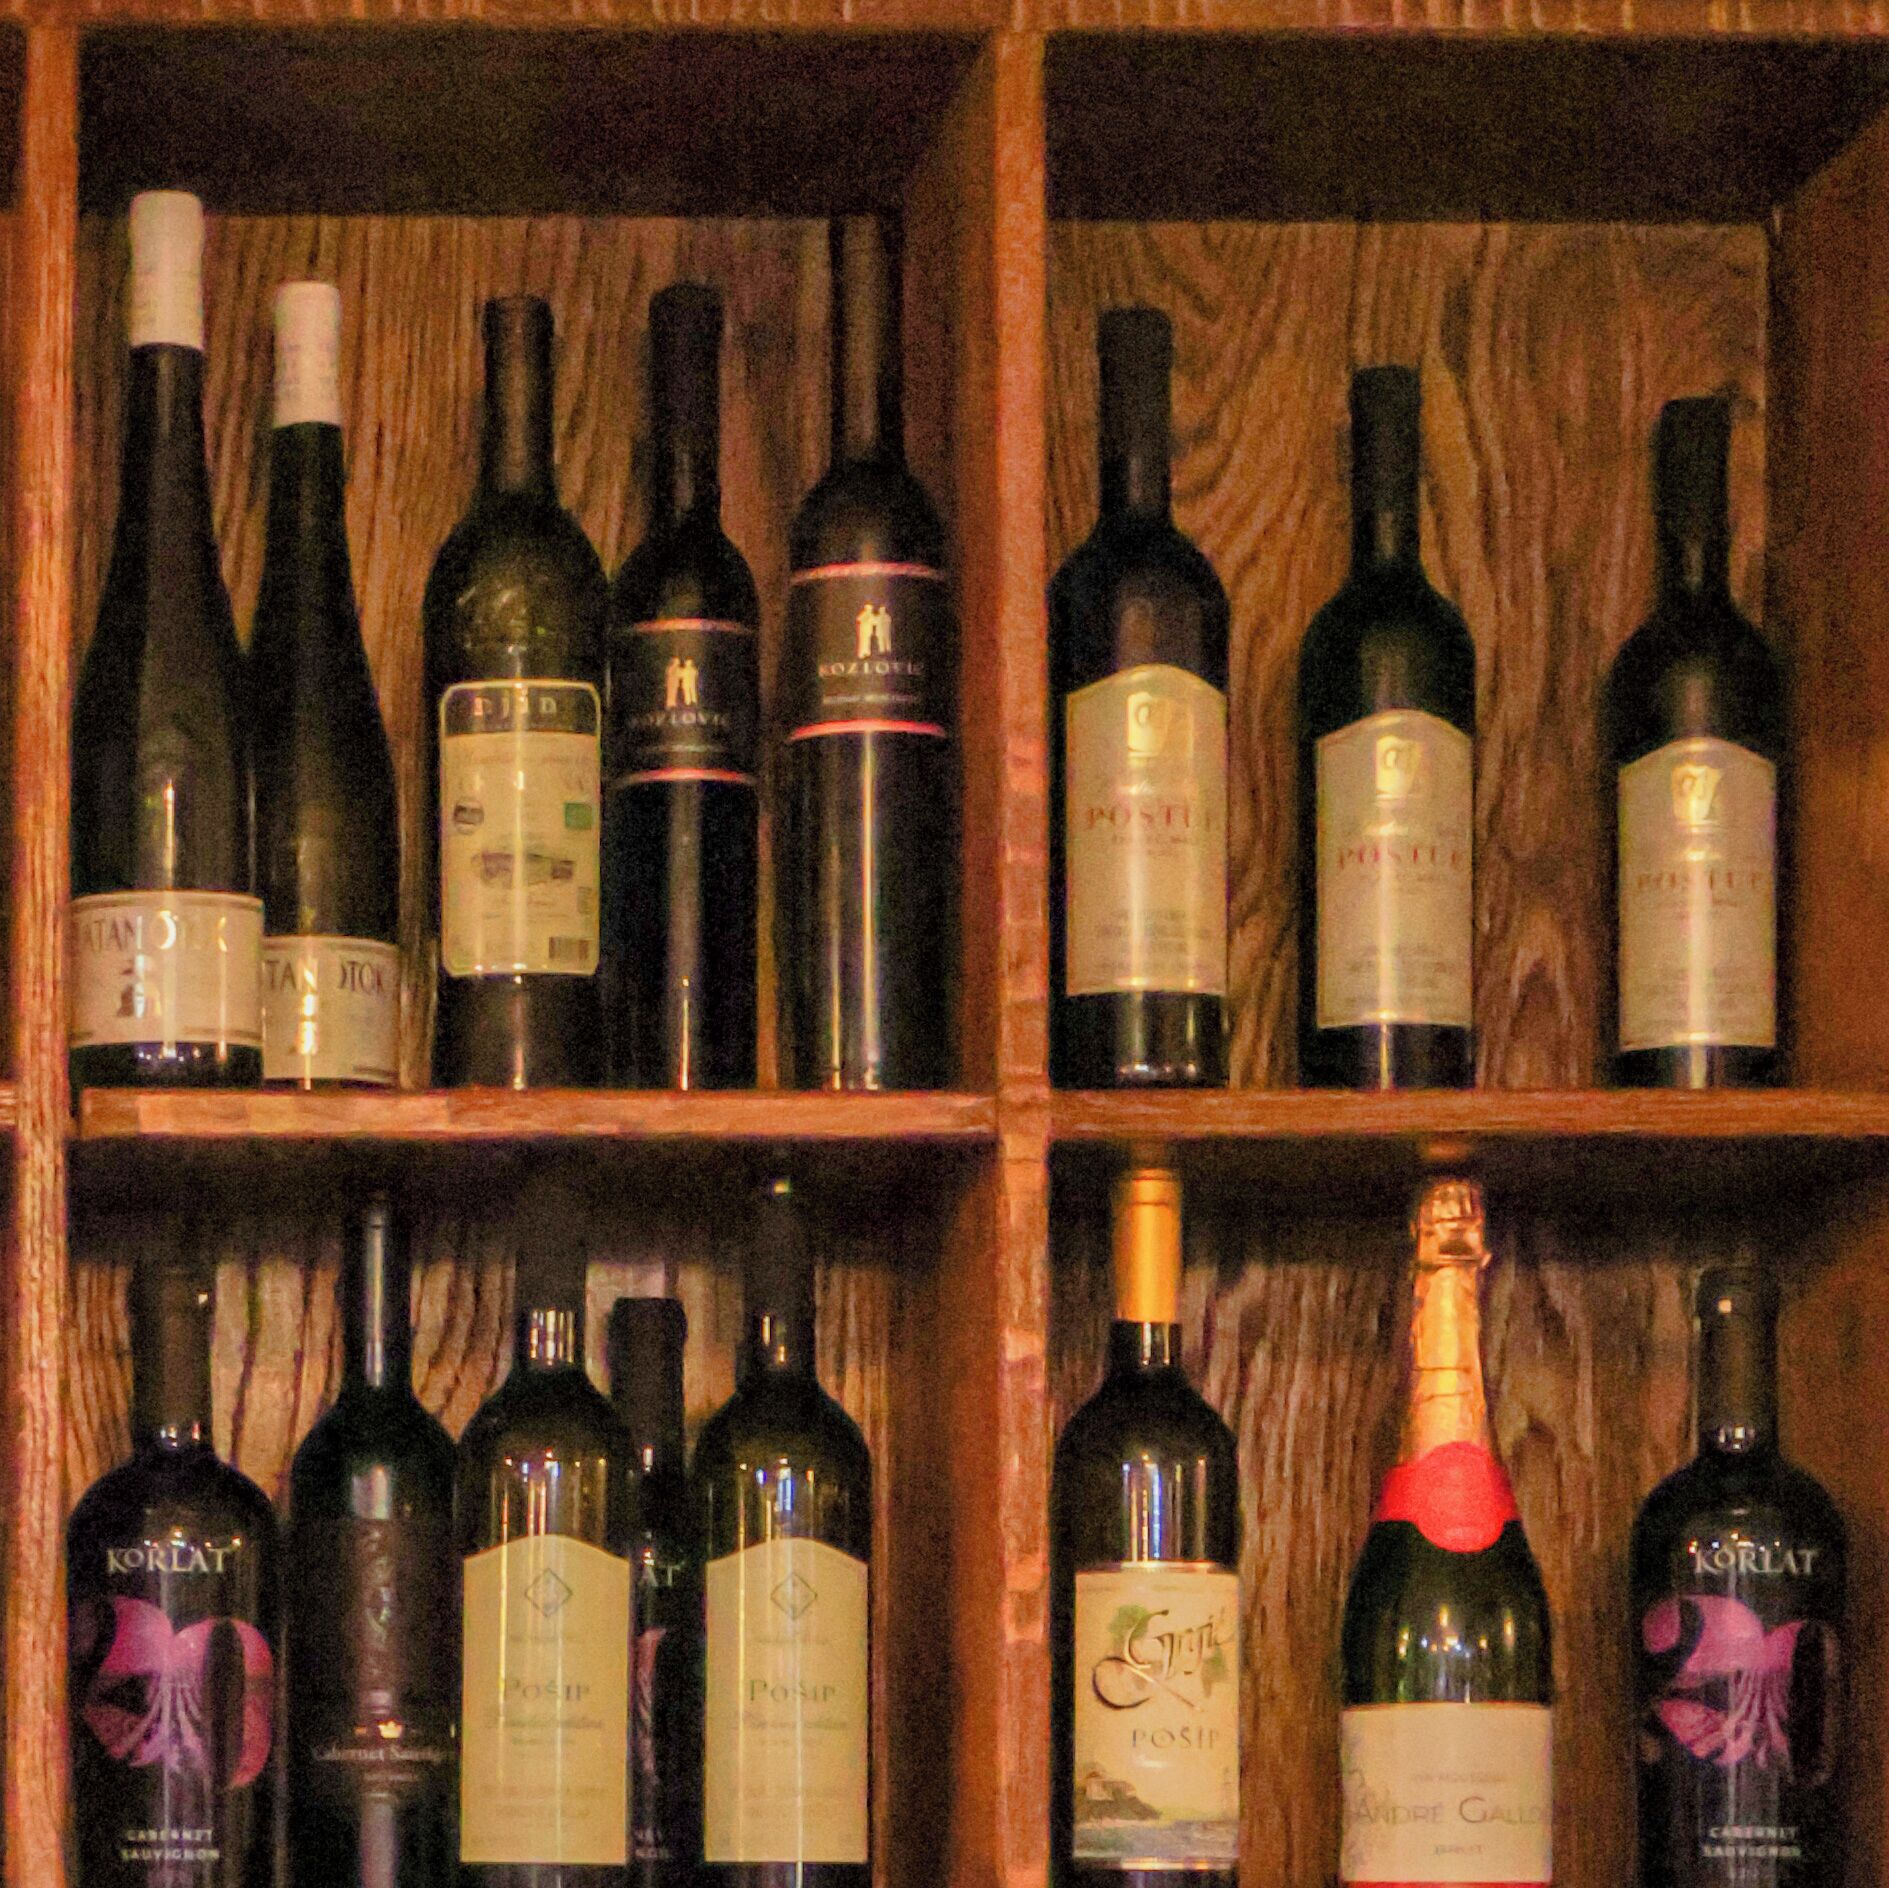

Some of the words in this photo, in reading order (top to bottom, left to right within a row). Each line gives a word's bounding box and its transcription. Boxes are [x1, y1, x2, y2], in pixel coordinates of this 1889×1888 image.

[108, 1548, 235, 1574] KORLAT
[1695, 1548, 1820, 1575] KORLAT
[1131, 1726, 1220, 1750] POŠIP
[126, 1828, 214, 1842] CABERNET
[121, 1848, 221, 1862] SAUVIGNON
